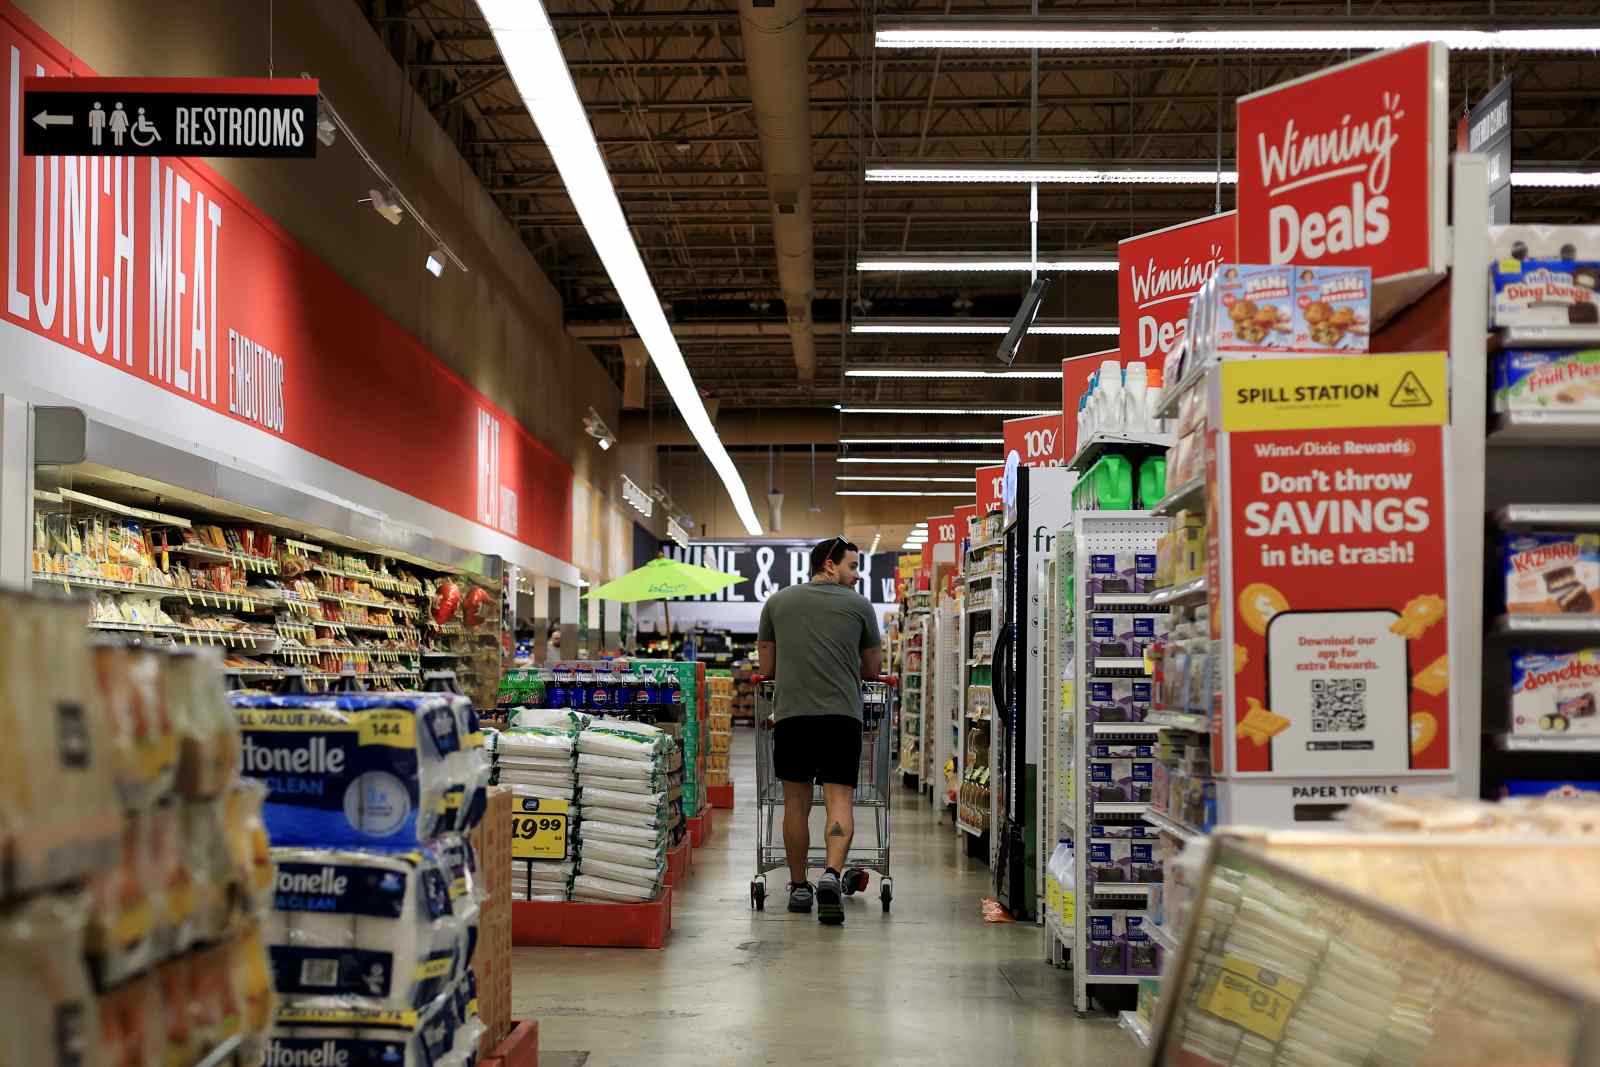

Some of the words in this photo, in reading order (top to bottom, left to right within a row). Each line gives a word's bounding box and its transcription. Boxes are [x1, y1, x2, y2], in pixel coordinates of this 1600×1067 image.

[176, 107, 304, 147] RESTROOMS
[1258, 113, 1398, 194] Winning
[8, 45, 135, 366] LUNCH
[149, 156, 222, 405] MEAT
[1269, 181, 1390, 265] Deals
[1507, 286, 1543, 301] Ding
[1139, 316, 1189, 358] Dea
[229, 328, 285, 433] EMBUTIDOS
[1528, 365, 1564, 392] Fruit
[1237, 387, 1290, 404] SPILL
[1295, 384, 1379, 402] STATION
[1343, 439, 1409, 455] Rewards
[1260, 470, 1330, 494] Don't
[1335, 468, 1413, 491] throw
[1244, 496, 1430, 537] SAVINGS
[1033, 526, 1056, 553] fr
[1261, 544, 1285, 566] in
[1291, 542, 1334, 565] the
[1339, 540, 1414, 564] trash!
[754, 546, 779, 602] &
[788, 549, 871, 602] BR
[1298, 636, 1355, 647] Download
[1357, 637, 1377, 646] our
[1317, 649, 1339, 660] app
[1341, 648, 1358, 658] for
[1296, 661, 1326, 671] extra
[1328, 659, 1379, 671] Rewards.
[261, 713, 304, 726] VALUE
[372, 722, 401, 736] 144
[1292, 786, 1337, 798] PAPER
